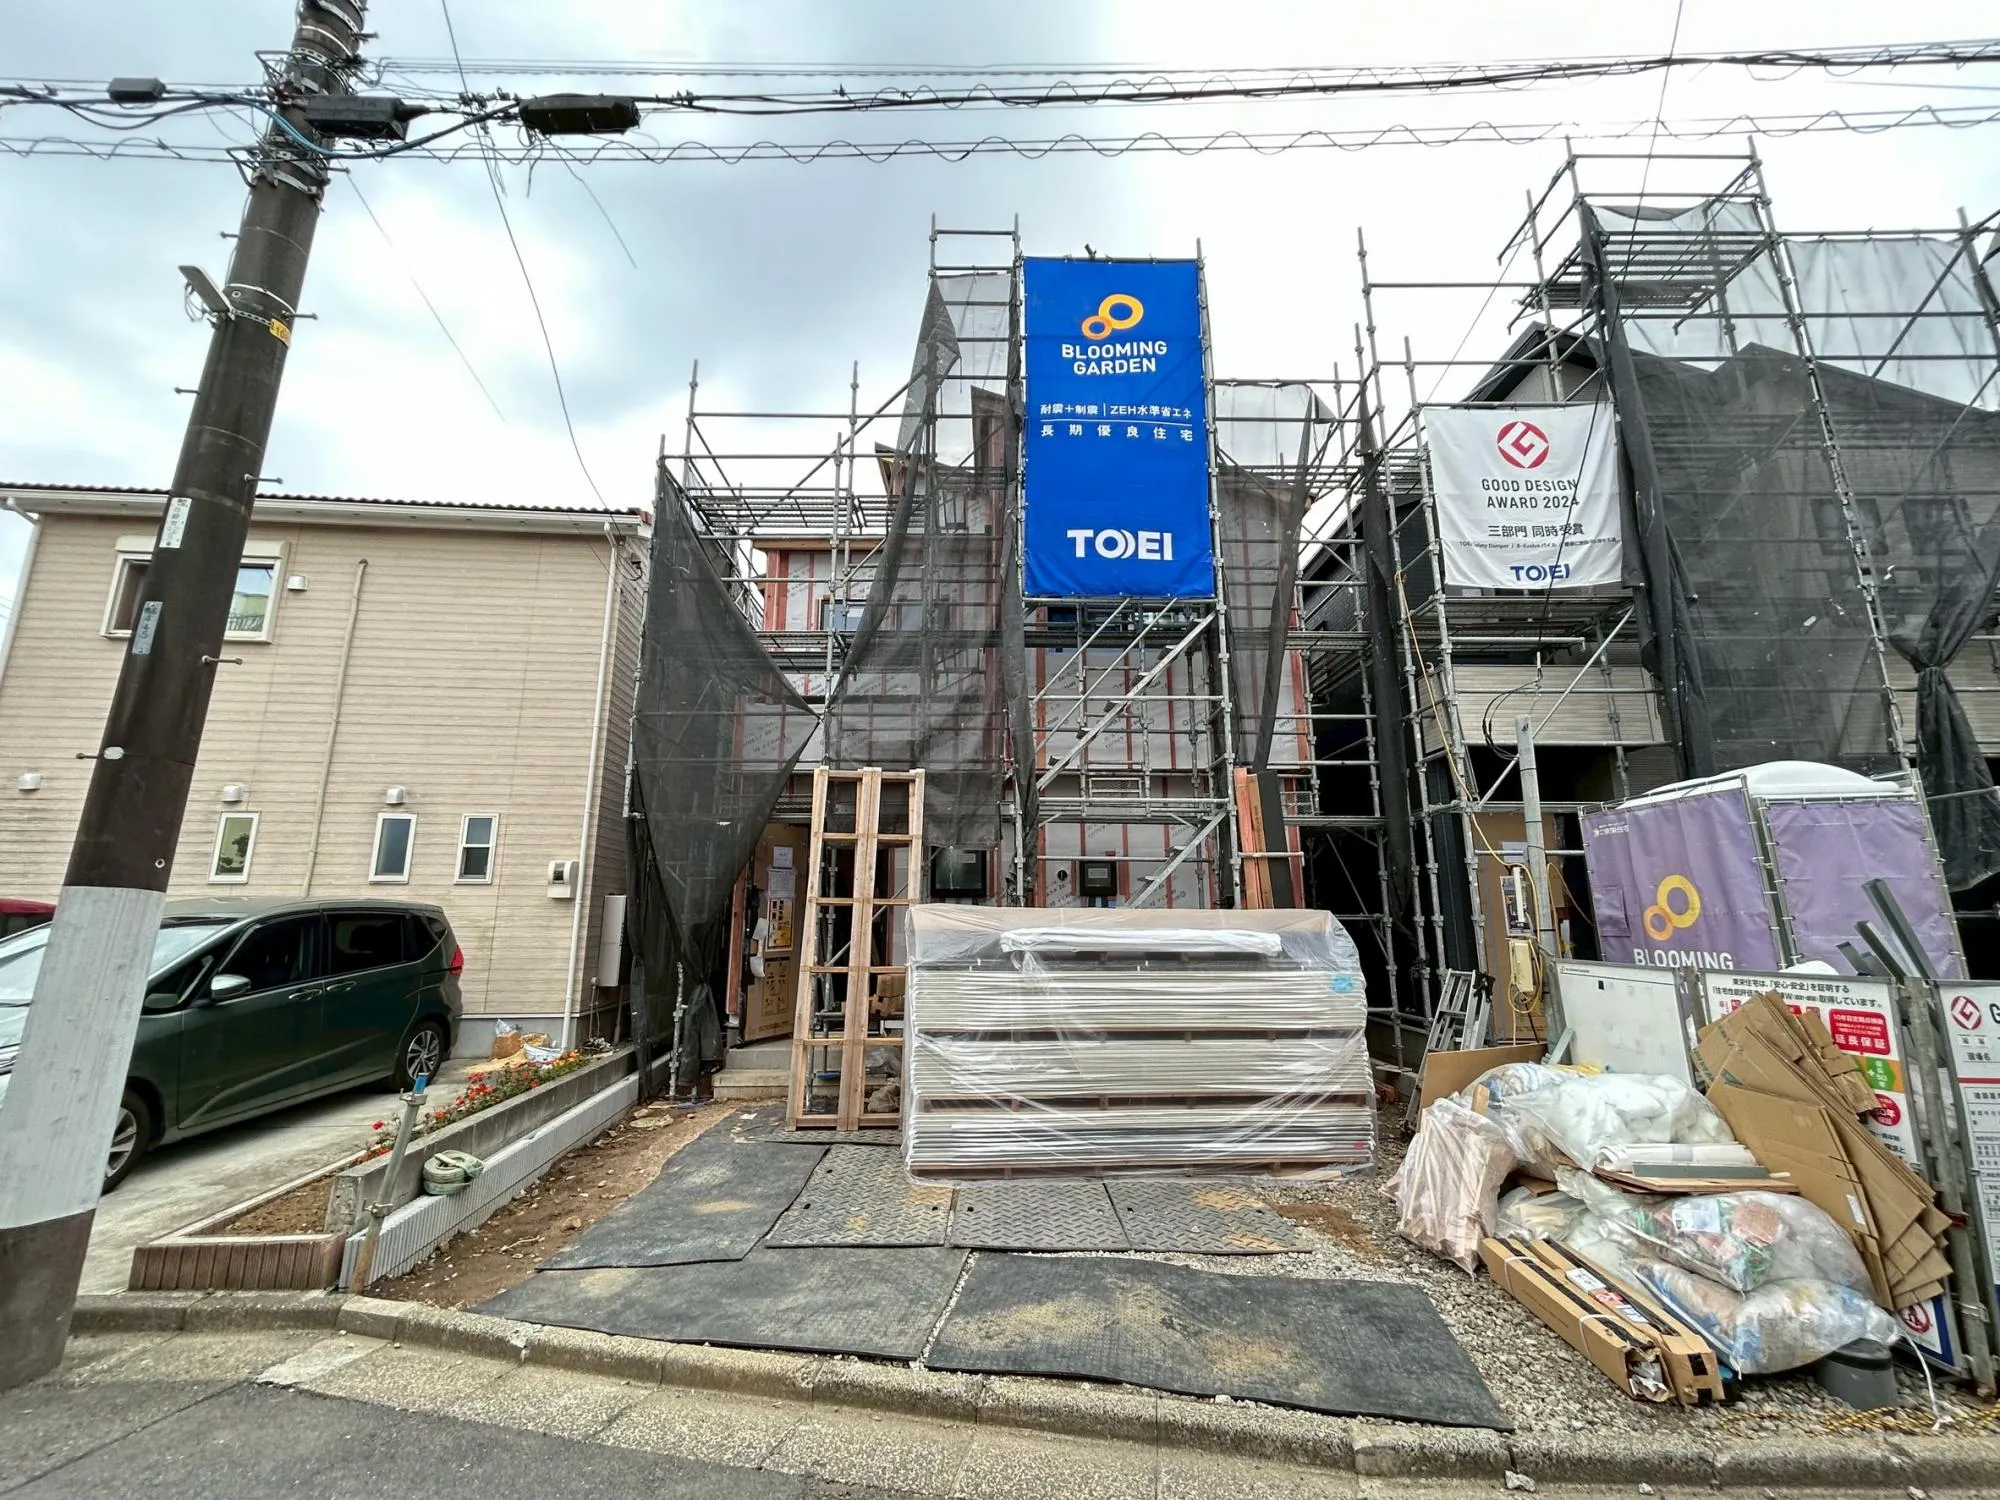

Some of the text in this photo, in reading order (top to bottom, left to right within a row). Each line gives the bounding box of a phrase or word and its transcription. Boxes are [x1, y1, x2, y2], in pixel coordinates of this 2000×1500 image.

[1061, 340, 1168, 359] BLOOMING
[1073, 357, 1156, 375] GARDEN
[1481, 478, 1577, 492] GOOD DESIGN
[1487, 495, 1579, 509] AWARD 2024
[1488, 522, 1584, 538] 三部門 同時受賞
[1066, 529, 1173, 561] TOEI
[1510, 564, 1570, 581] TOEI
[1632, 948, 1734, 970] BLOOMING
